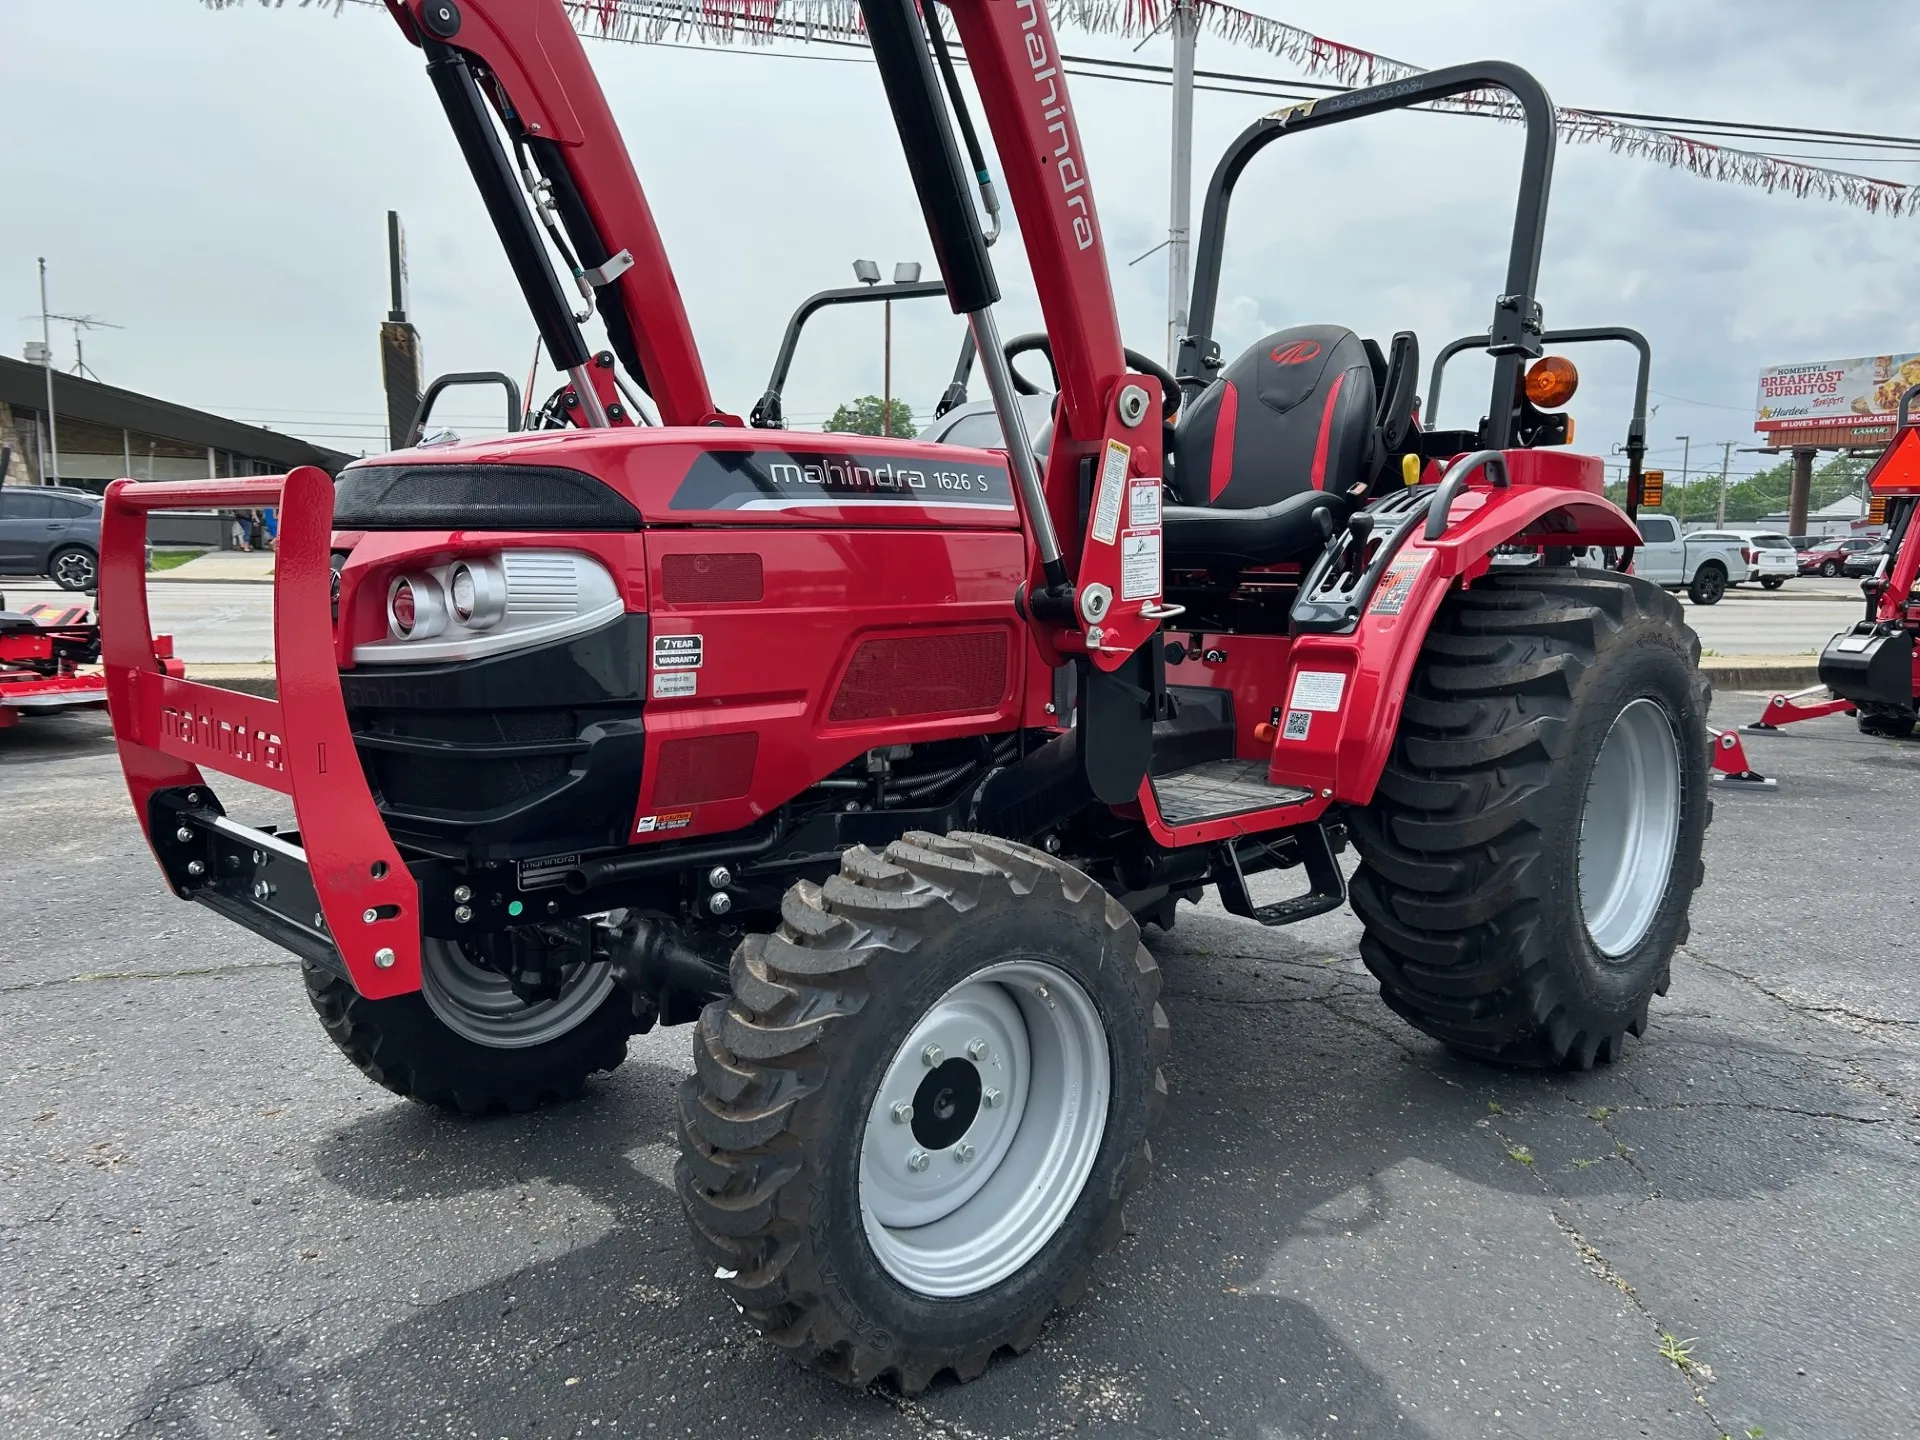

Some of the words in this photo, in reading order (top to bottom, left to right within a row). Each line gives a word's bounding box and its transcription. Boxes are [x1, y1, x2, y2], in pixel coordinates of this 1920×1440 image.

[1777, 365, 1828, 375] HOMESTYLE
[1761, 371, 1844, 387] BREAKFAST
[1765, 383, 1837, 398] BURRITOS
[1853, 414, 1897, 423] LANCASTER
[1853, 427, 1886, 435] LAMAR
[769, 459, 926, 489] mahindra
[932, 472, 971, 491] 1626
[977, 475, 988, 492] S
[663, 640, 670, 649] 7
[671, 640, 693, 648] YEAR
[659, 656, 697, 664] WARRANTY
[160, 704, 284, 771] mahindra
[522, 855, 575, 869] mahindra
